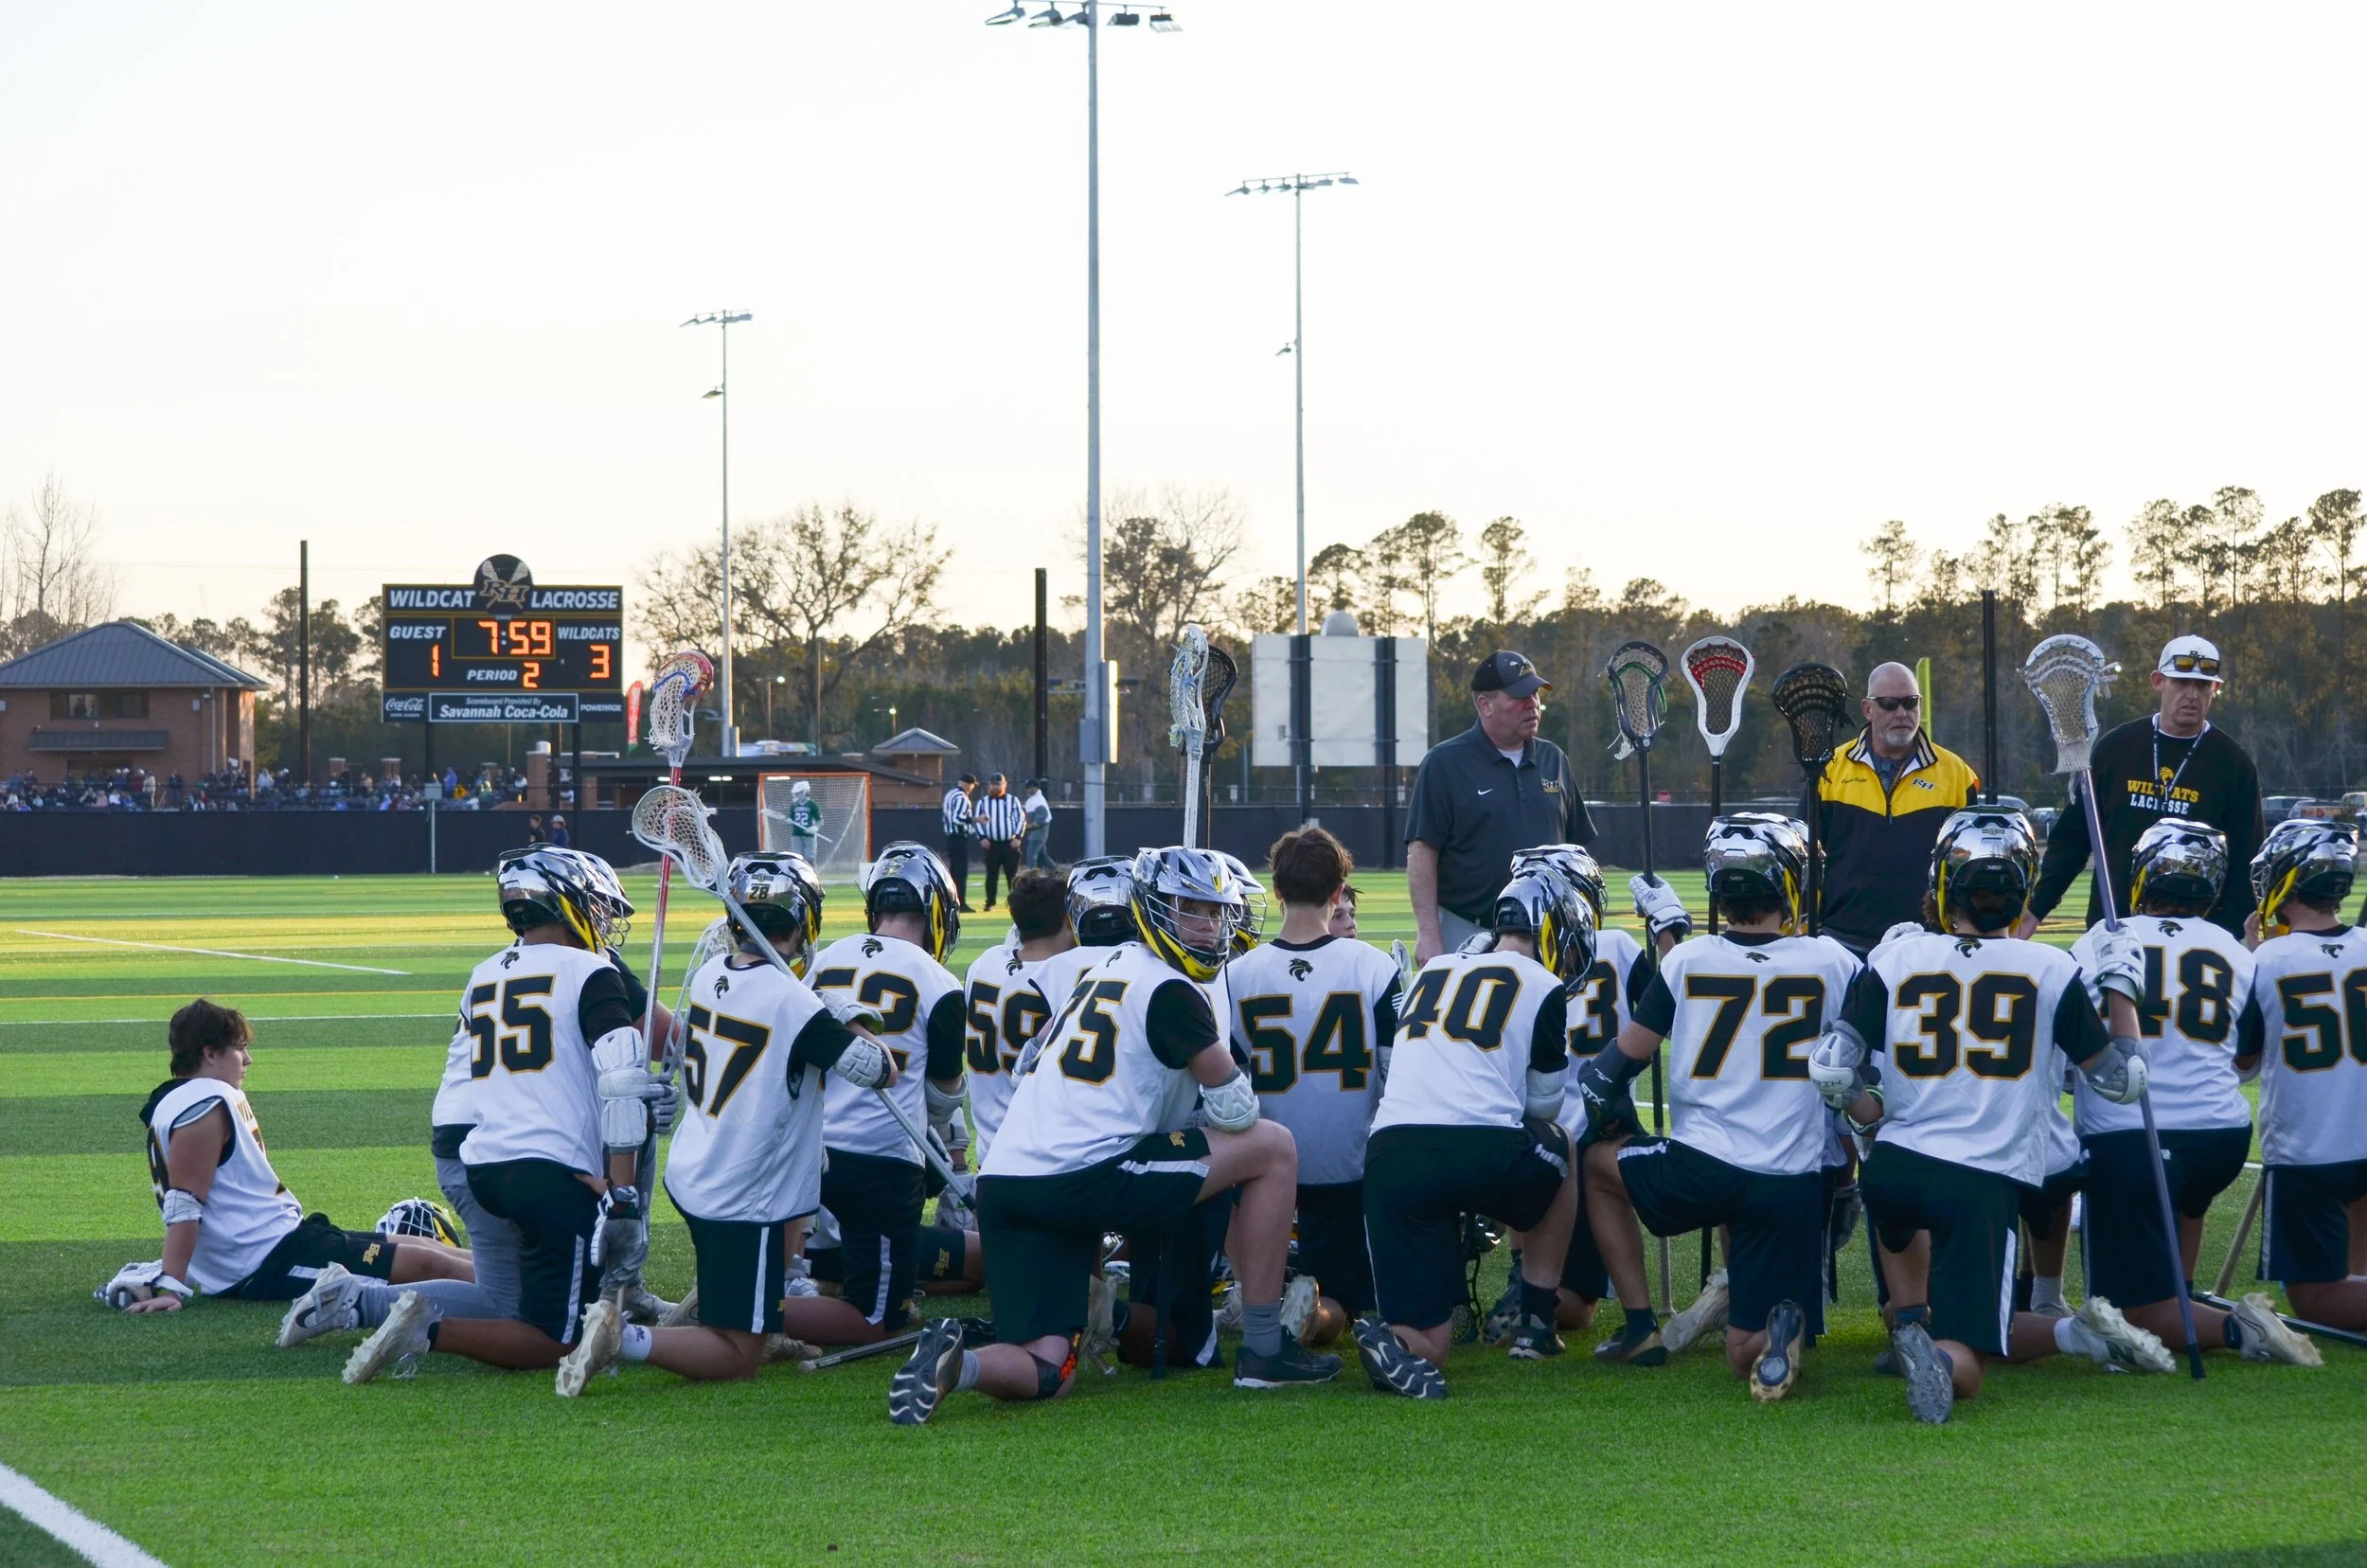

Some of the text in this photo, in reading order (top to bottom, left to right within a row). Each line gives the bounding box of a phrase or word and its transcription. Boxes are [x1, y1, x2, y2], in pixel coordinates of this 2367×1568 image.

[389, 590, 619, 609] WILDCAT LACROSSE
[389, 626, 446, 639] GUEST
[478, 621, 551, 655] 7:59
[558, 627, 620, 640] WILDCATS
[432, 644, 439, 677] 1
[467, 669, 518, 681] PERIOD
[523, 662, 540, 688] 2
[590, 645, 610, 678] 3
[439, 704, 568, 718] Savannah Coca-Cola
[1912, 778, 1936, 790] RH
[2127, 779, 2200, 803] WILATS
[795, 812, 809, 826] 22
[1396, 966, 1522, 1052] 40
[471, 973, 556, 1079] 55
[965, 978, 1053, 1077] 59
[1025, 978, 1131, 1086] 75
[1684, 973, 1825, 1080] 72
[1895, 971, 2038, 1080] 39
[1238, 990, 1373, 1095] 54
[1581, 1082, 1606, 1106] STX
